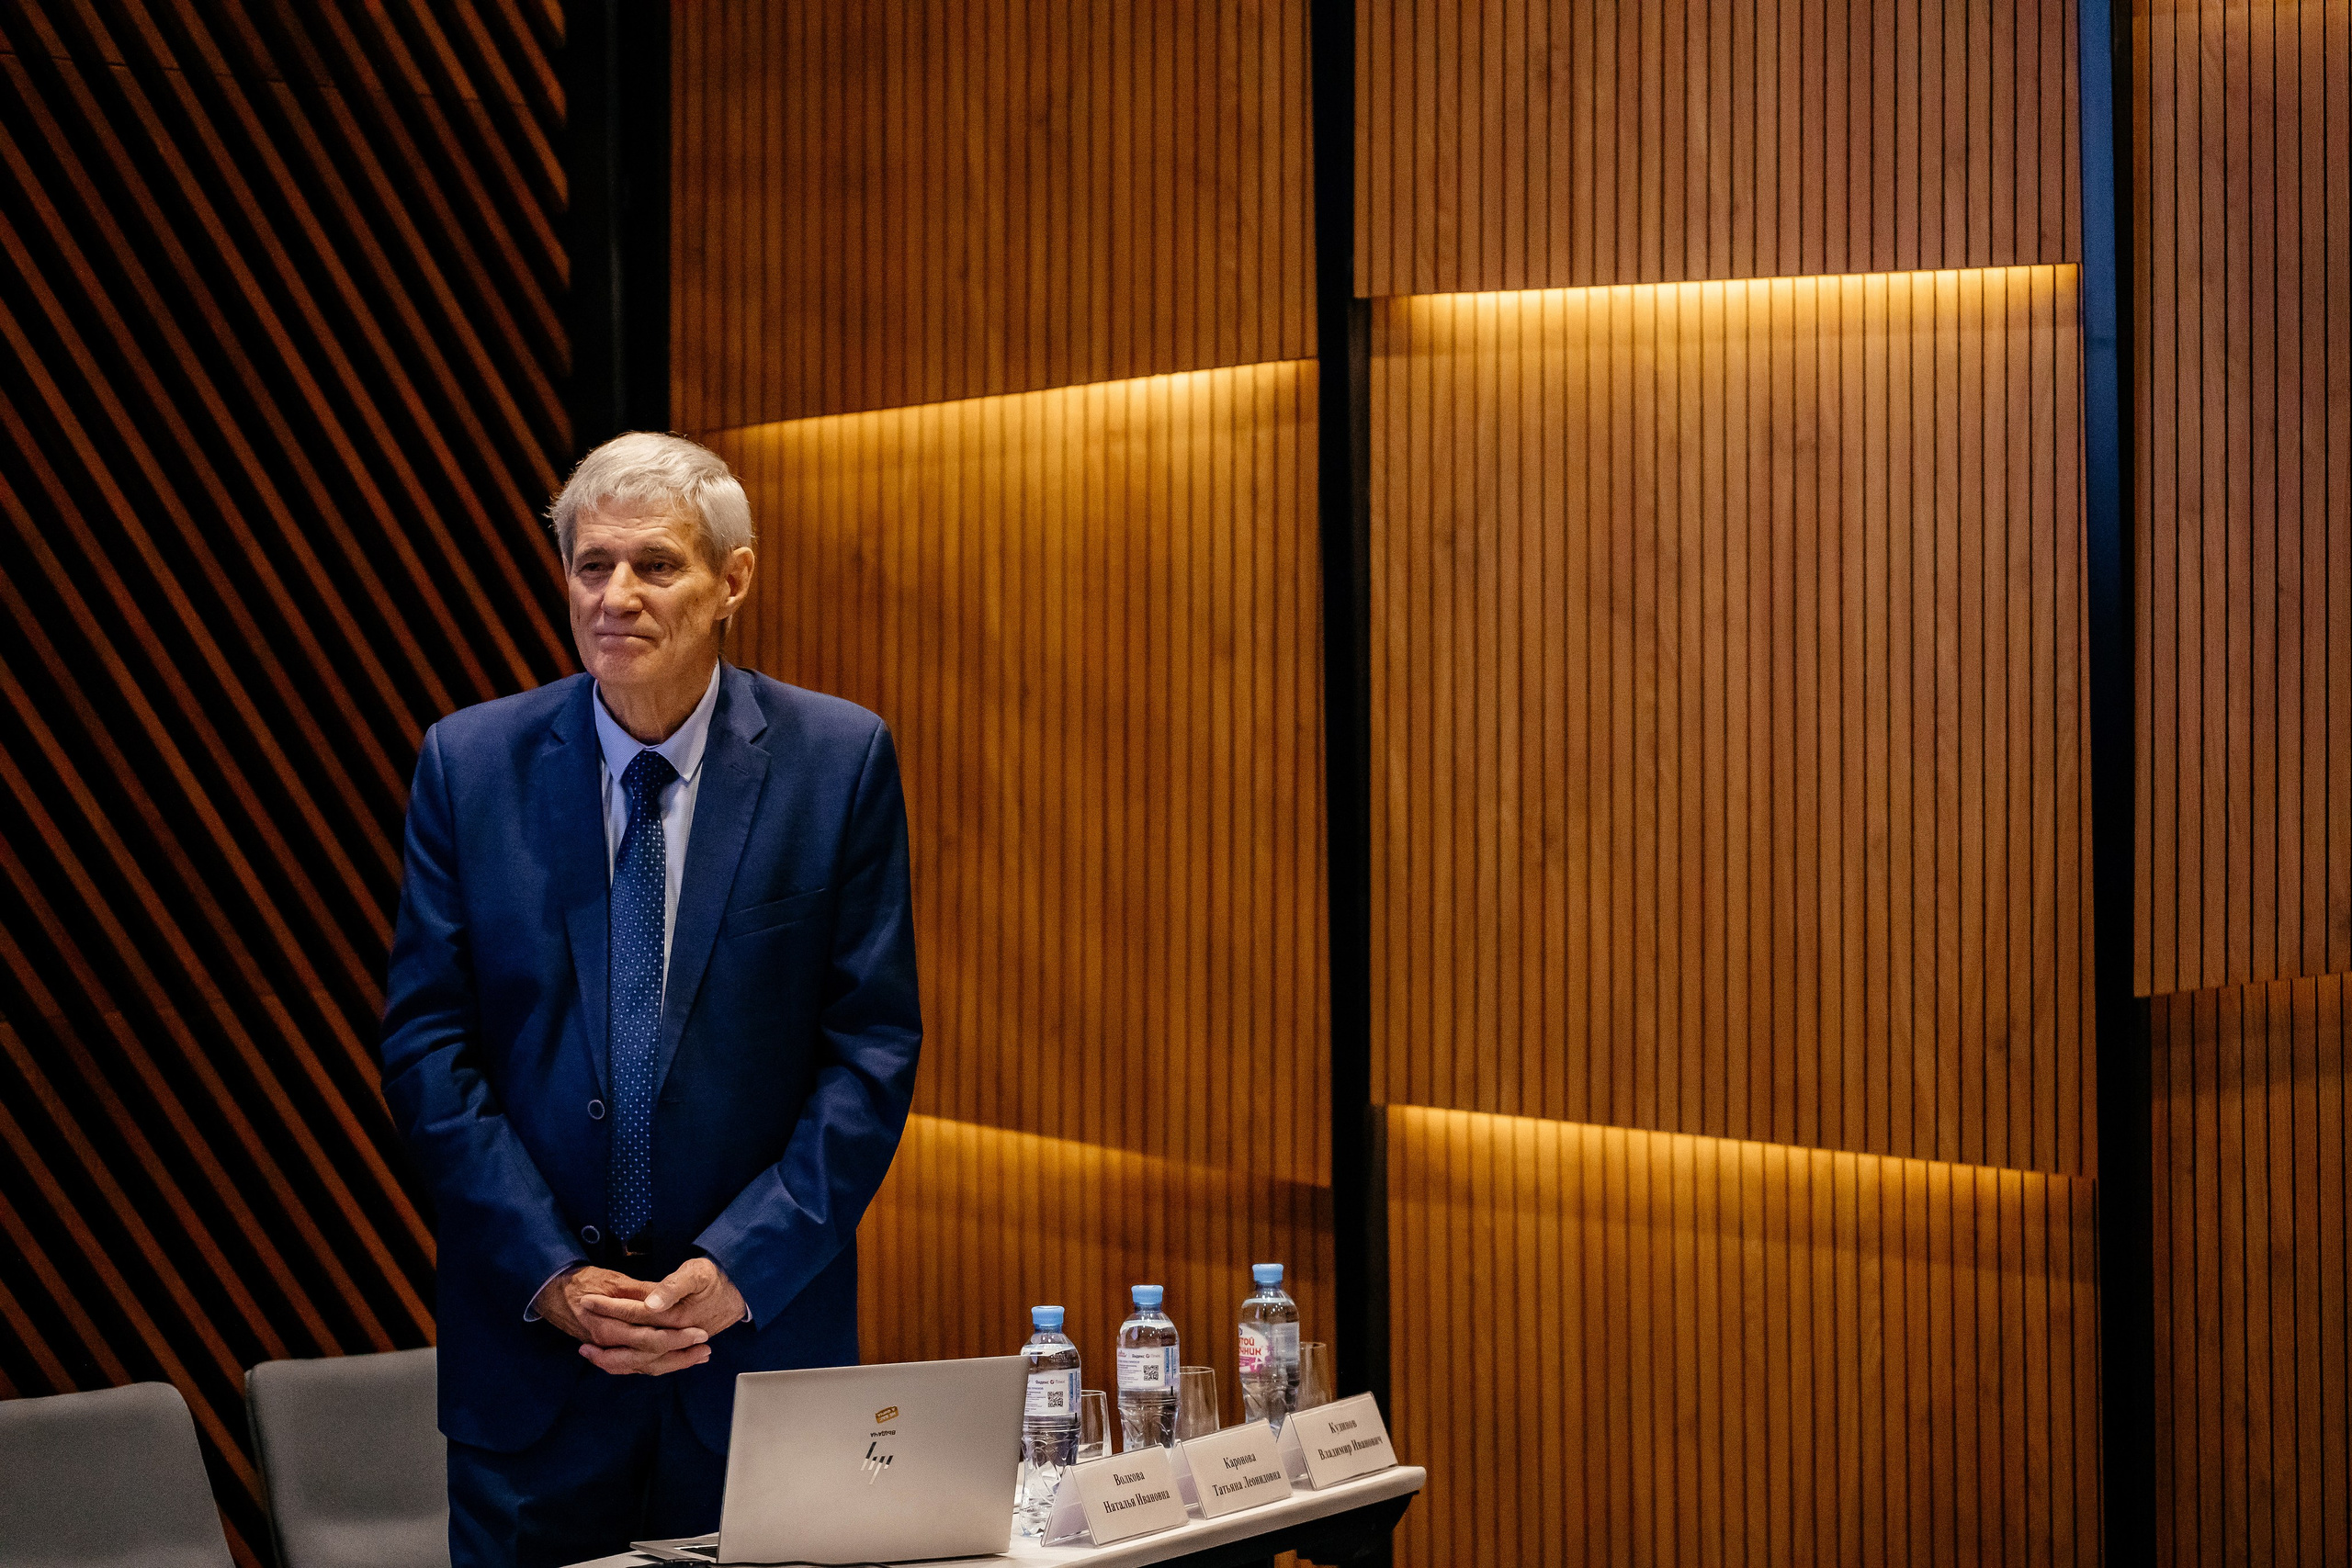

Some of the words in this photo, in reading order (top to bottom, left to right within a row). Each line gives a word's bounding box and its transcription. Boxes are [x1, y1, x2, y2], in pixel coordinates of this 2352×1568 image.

[1238, 1347, 1261, 1356] ЧНИК
[1317, 1444, 1352, 1461] Владимир
[1351, 1436, 1384, 1450] Иванович
[860, 1441, 894, 1484] hp
[1223, 1453, 1256, 1470] Каронова
[1113, 1472, 1145, 1485] Волкова
[1212, 1481, 1243, 1496] Татьяна
[1243, 1471, 1282, 1488] Леонидовна
[1102, 1497, 1136, 1513] Наталья
[1135, 1490, 1170, 1506] Ивановна
